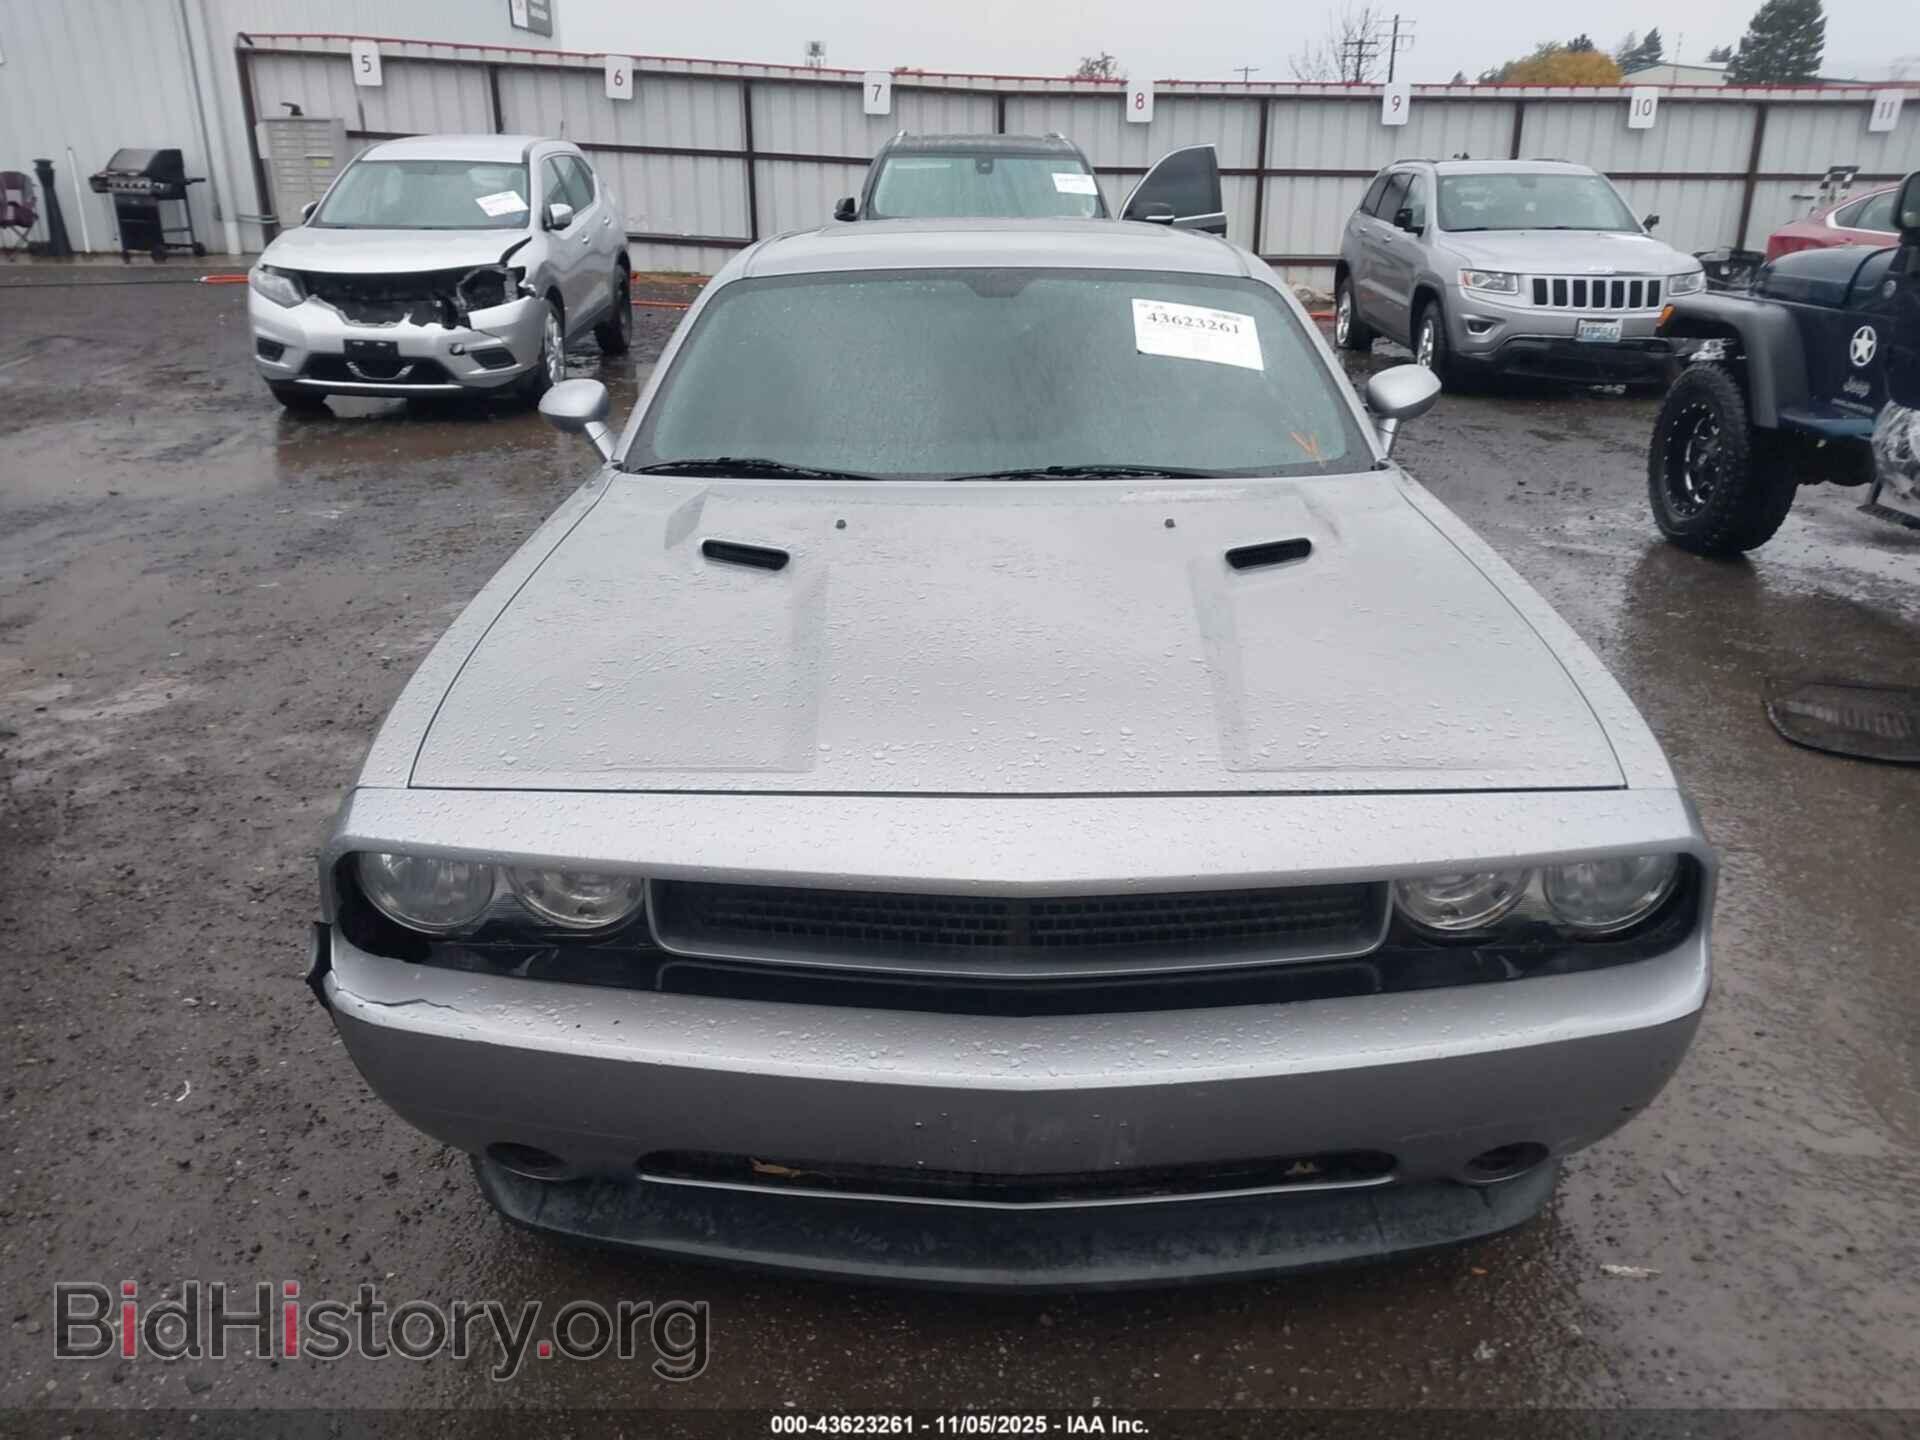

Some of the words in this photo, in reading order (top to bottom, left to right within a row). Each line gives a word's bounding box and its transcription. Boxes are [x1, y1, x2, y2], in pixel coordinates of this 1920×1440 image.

[361, 54, 372, 73] 5
[614, 69, 624, 87] 6
[871, 83, 882, 102] 7
[1135, 92, 1145, 110] 8
[1391, 95, 1401, 112] 9
[1634, 98, 1652, 116] 10
[1879, 101, 1895, 119] 11
[1146, 312, 1239, 334] 43623261
